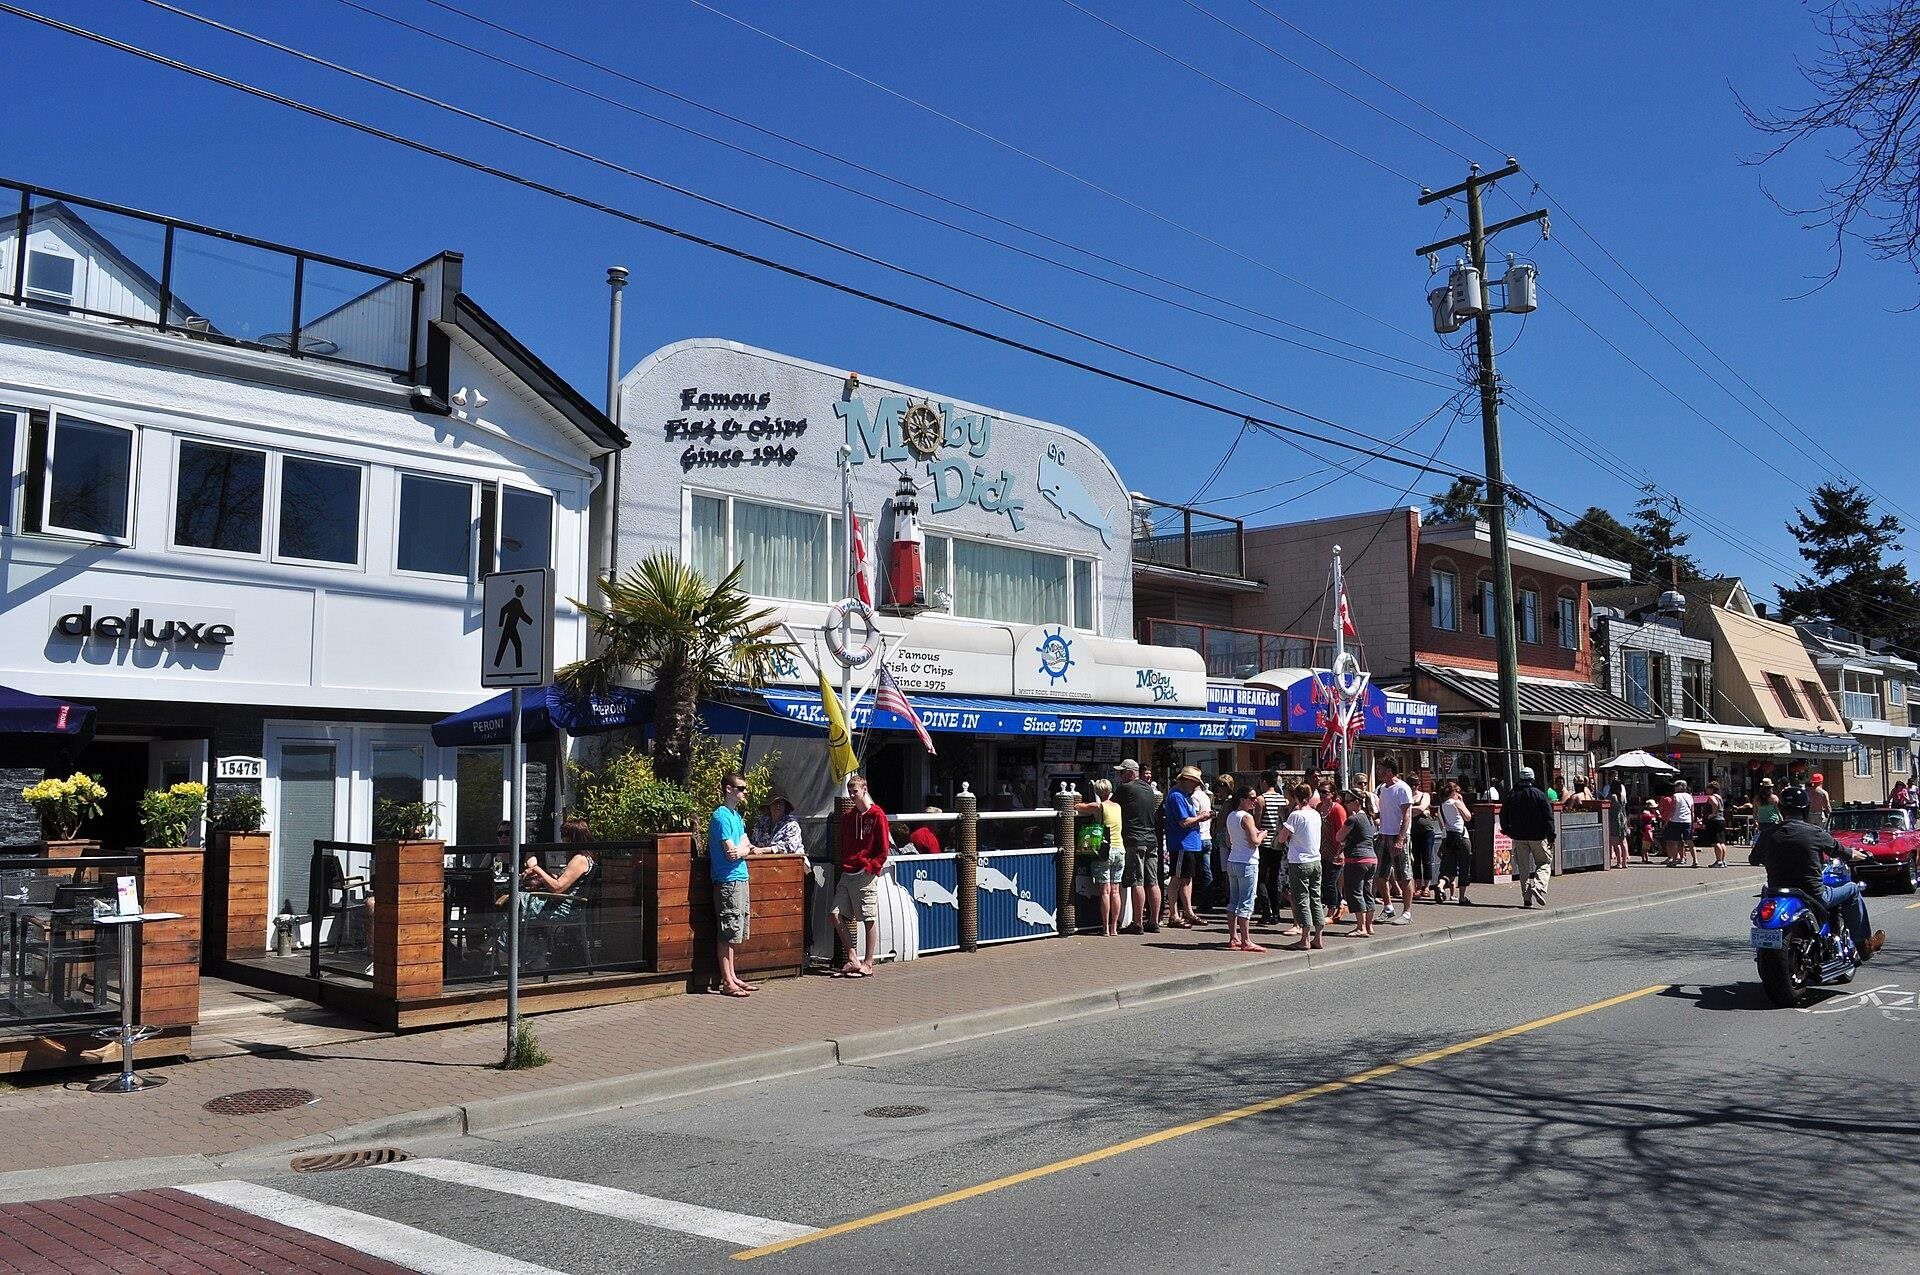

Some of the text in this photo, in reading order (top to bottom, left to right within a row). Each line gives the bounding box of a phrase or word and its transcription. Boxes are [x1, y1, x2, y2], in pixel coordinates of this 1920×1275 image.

[680, 387, 771, 410] Famous
[748, 416, 808, 438] Chips
[680, 444, 744, 472] Since
[926, 457, 1025, 532] Dick
[57, 604, 235, 645] deluxe
[898, 649, 940, 661] Famous
[911, 662, 920, 673] &
[923, 664, 954, 677] Chips
[924, 680, 946, 690] 1975
[1136, 669, 1171, 688] Moby
[1152, 685, 1178, 702] Dick
[1236, 690, 1281, 707] BREAKFAST
[592, 703, 626, 716] PERONI
[1237, 706, 1248, 715] TAKE
[1247, 707, 1257, 715] OUT
[1405, 702, 1438, 717] BREAKFAST
[472, 718, 504, 733] PERONI
[786, 704, 829, 722] TAK
[922, 711, 960, 728] DINE
[961, 713, 981, 729] IN
[1023, 716, 1057, 732] Since
[1058, 719, 1083, 733] 1975
[1124, 721, 1152, 734] DINE
[1154, 722, 1167, 734] IN
[1198, 724, 1225, 736] TAKE
[1226, 724, 1248, 737] OUT
[222, 762, 259, 775] 15475
